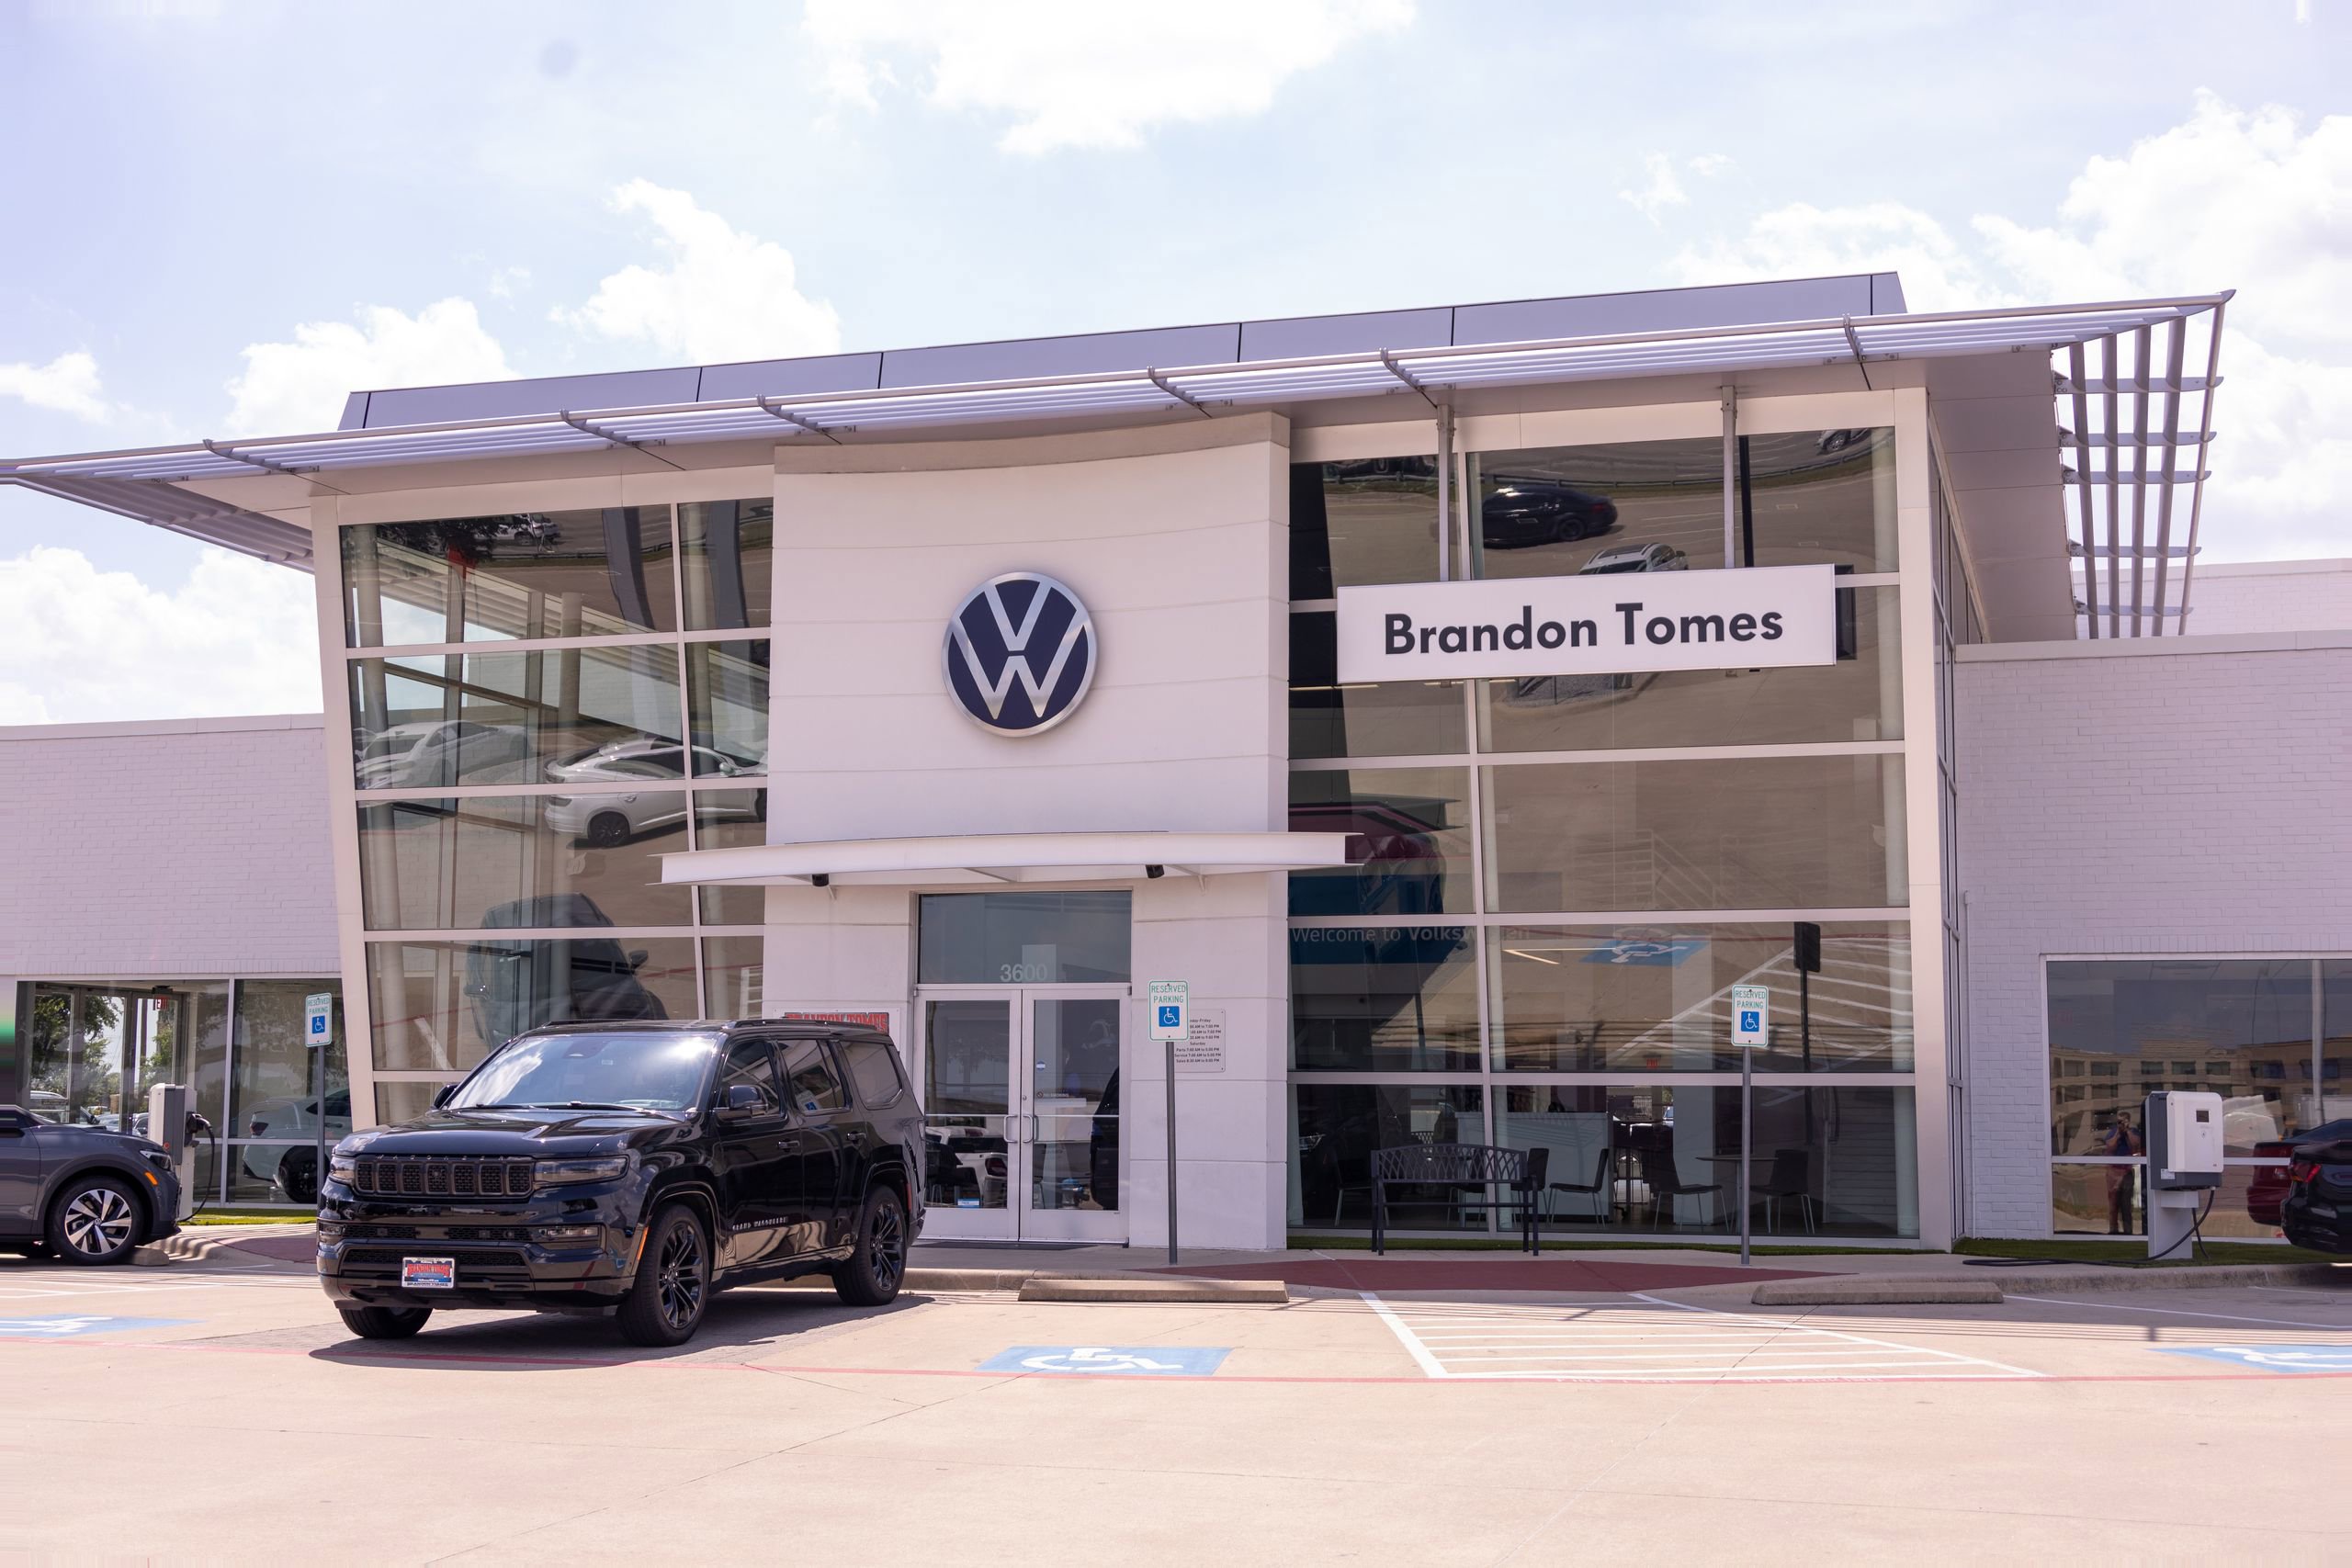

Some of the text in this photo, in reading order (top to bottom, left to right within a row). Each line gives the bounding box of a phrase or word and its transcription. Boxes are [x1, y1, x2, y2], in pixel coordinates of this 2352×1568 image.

[1385, 602, 1783, 655] Brandon Tomes
[1292, 927, 1376, 943] Welcome
[1381, 927, 1401, 942] to
[999, 963, 1048, 983] 3600
[1151, 985, 1187, 993] RESERVED
[1153, 995, 1184, 1003] PARKING
[1735, 990, 1766, 999] RESERVED
[1736, 1000, 1764, 1010] PARKING
